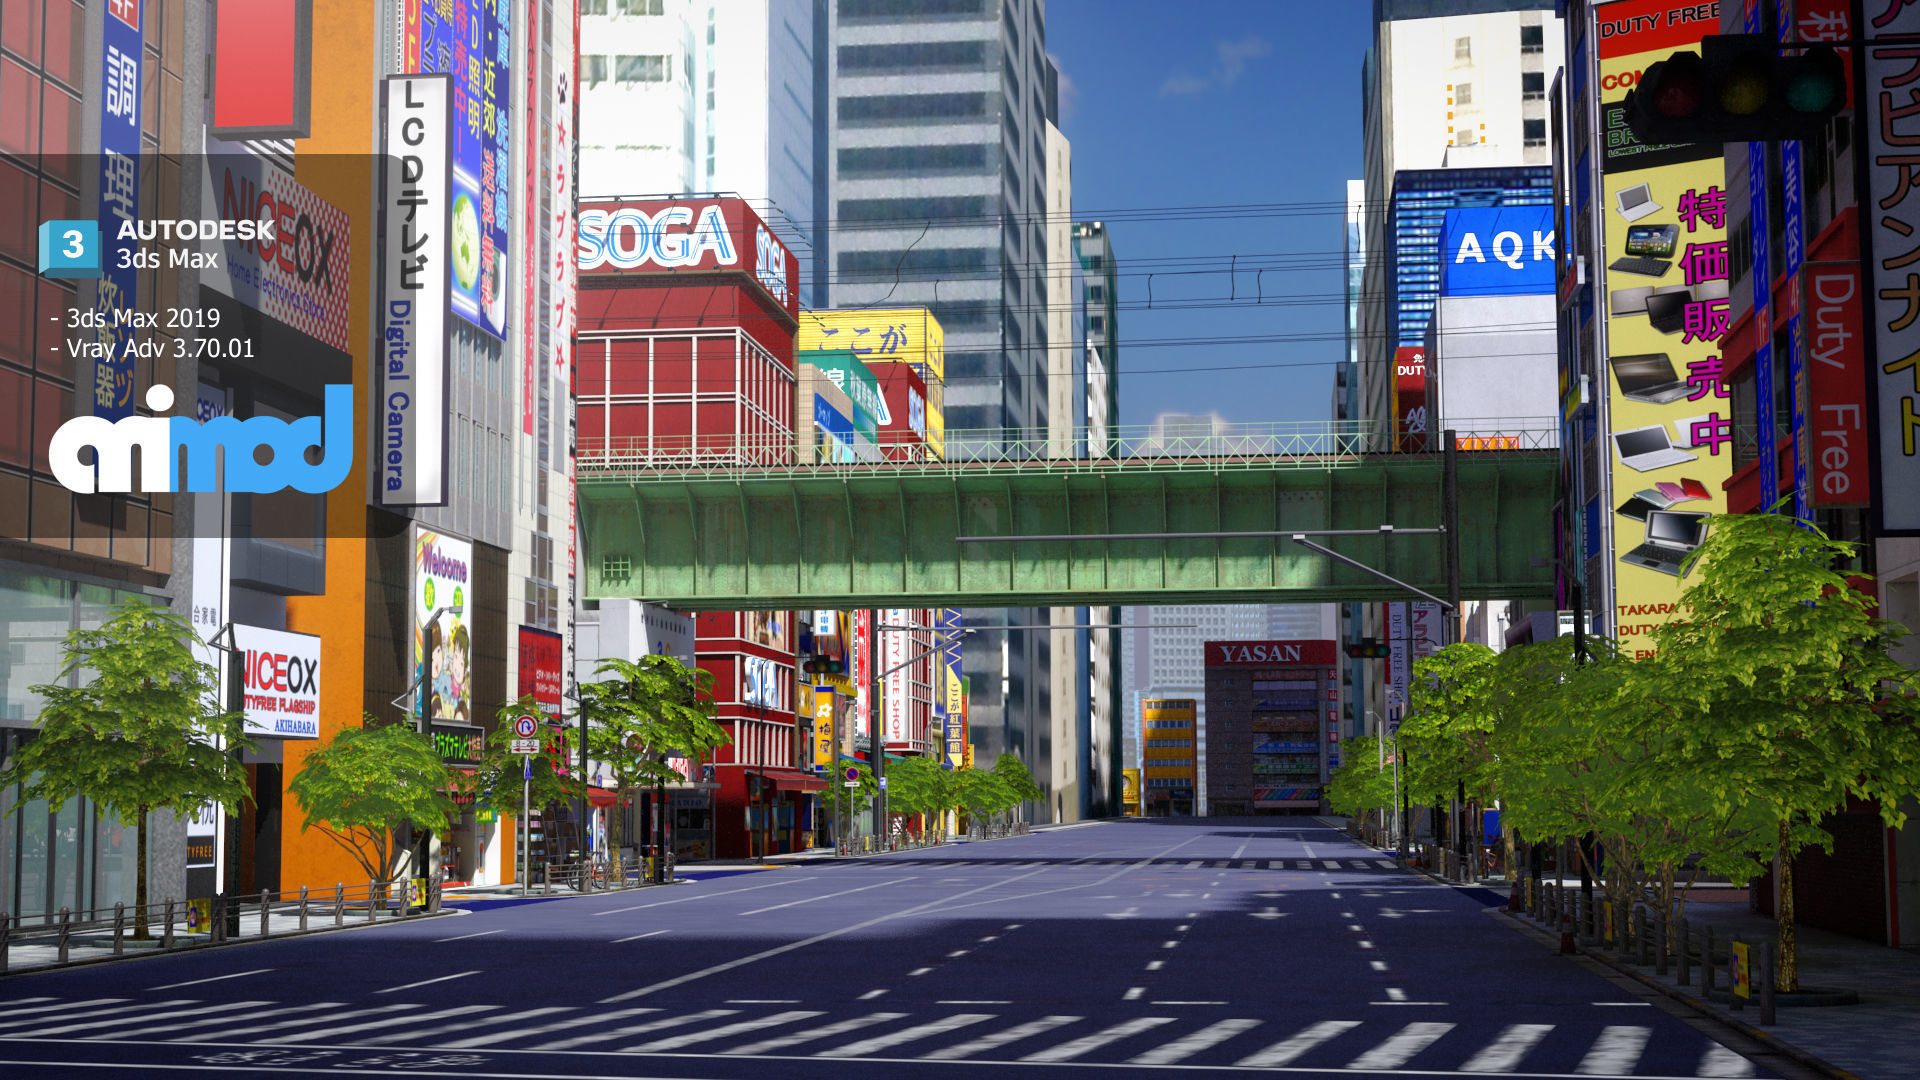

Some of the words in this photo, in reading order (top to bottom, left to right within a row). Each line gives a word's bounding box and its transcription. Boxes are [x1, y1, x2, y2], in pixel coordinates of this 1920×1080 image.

[1601, 13, 1661, 38] DUTY
[468, 0, 480, 139] D照明
[103, 44, 137, 222] 調理
[224, 167, 334, 295] NICEOX
[577, 205, 738, 270] SOGA
[227, 252, 251, 285] Home
[254, 267, 300, 309] Electronics
[303, 292, 335, 322] Store
[755, 223, 788, 307] SOGA
[385, 300, 411, 380] Digital
[1677, 185, 1731, 456] 特価販売中
[1811, 274, 1855, 369] Duty
[387, 391, 410, 491] Camera
[1819, 403, 1860, 495] Free
[423, 541, 468, 584] Welcome
[892, 618, 900, 656] DUTY
[1618, 603, 1678, 616] TAKARA
[892, 662, 900, 695] FREE
[1219, 644, 1303, 663] YASAN
[274, 719, 317, 735] AKIHABARA
[279, 697, 316, 715] FLAGSHIP
[892, 698, 901, 740] SHOP
